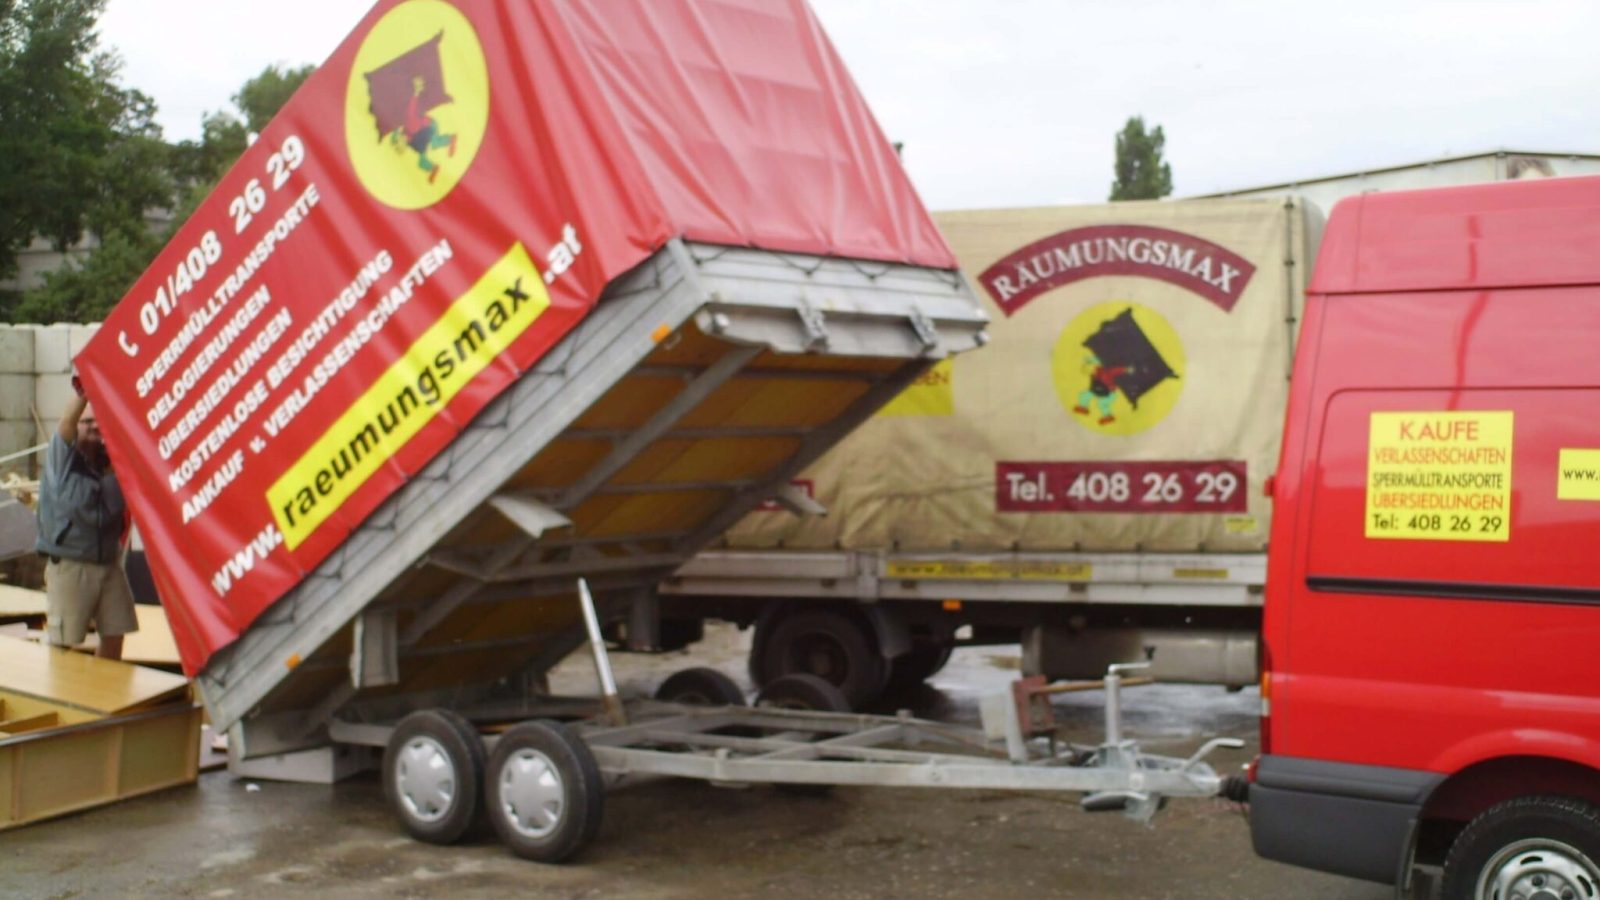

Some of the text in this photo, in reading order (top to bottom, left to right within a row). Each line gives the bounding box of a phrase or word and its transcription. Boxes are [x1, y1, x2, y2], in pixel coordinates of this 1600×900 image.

[140, 135, 304, 335] 01/408 26 29
[992, 237, 1241, 301] RÄUMUNGSMAX
[136, 183, 320, 398] SPERRMÜLLTRANSPORTE
[146, 284, 271, 430] DELOGIERUNGEN
[158, 307, 292, 460] ÜBERSIEDLUNGEN
[168, 249, 393, 492] KOSTENLOSE BESICHTIGUNG
[181, 450, 244, 523] ANKAUF
[263, 239, 453, 438] VERLASSENSCHAFTEN
[1373, 468, 1503, 489] SPERRMÜLLTRANSPORTE
[1374, 447, 1505, 464] VERLASSENSCHAFTEN
[1399, 421, 1479, 441] KAUFE
[1006, 472, 1237, 501] Tel. 408 26 29
[1373, 514, 1502, 532] Tel: 408 26 29
